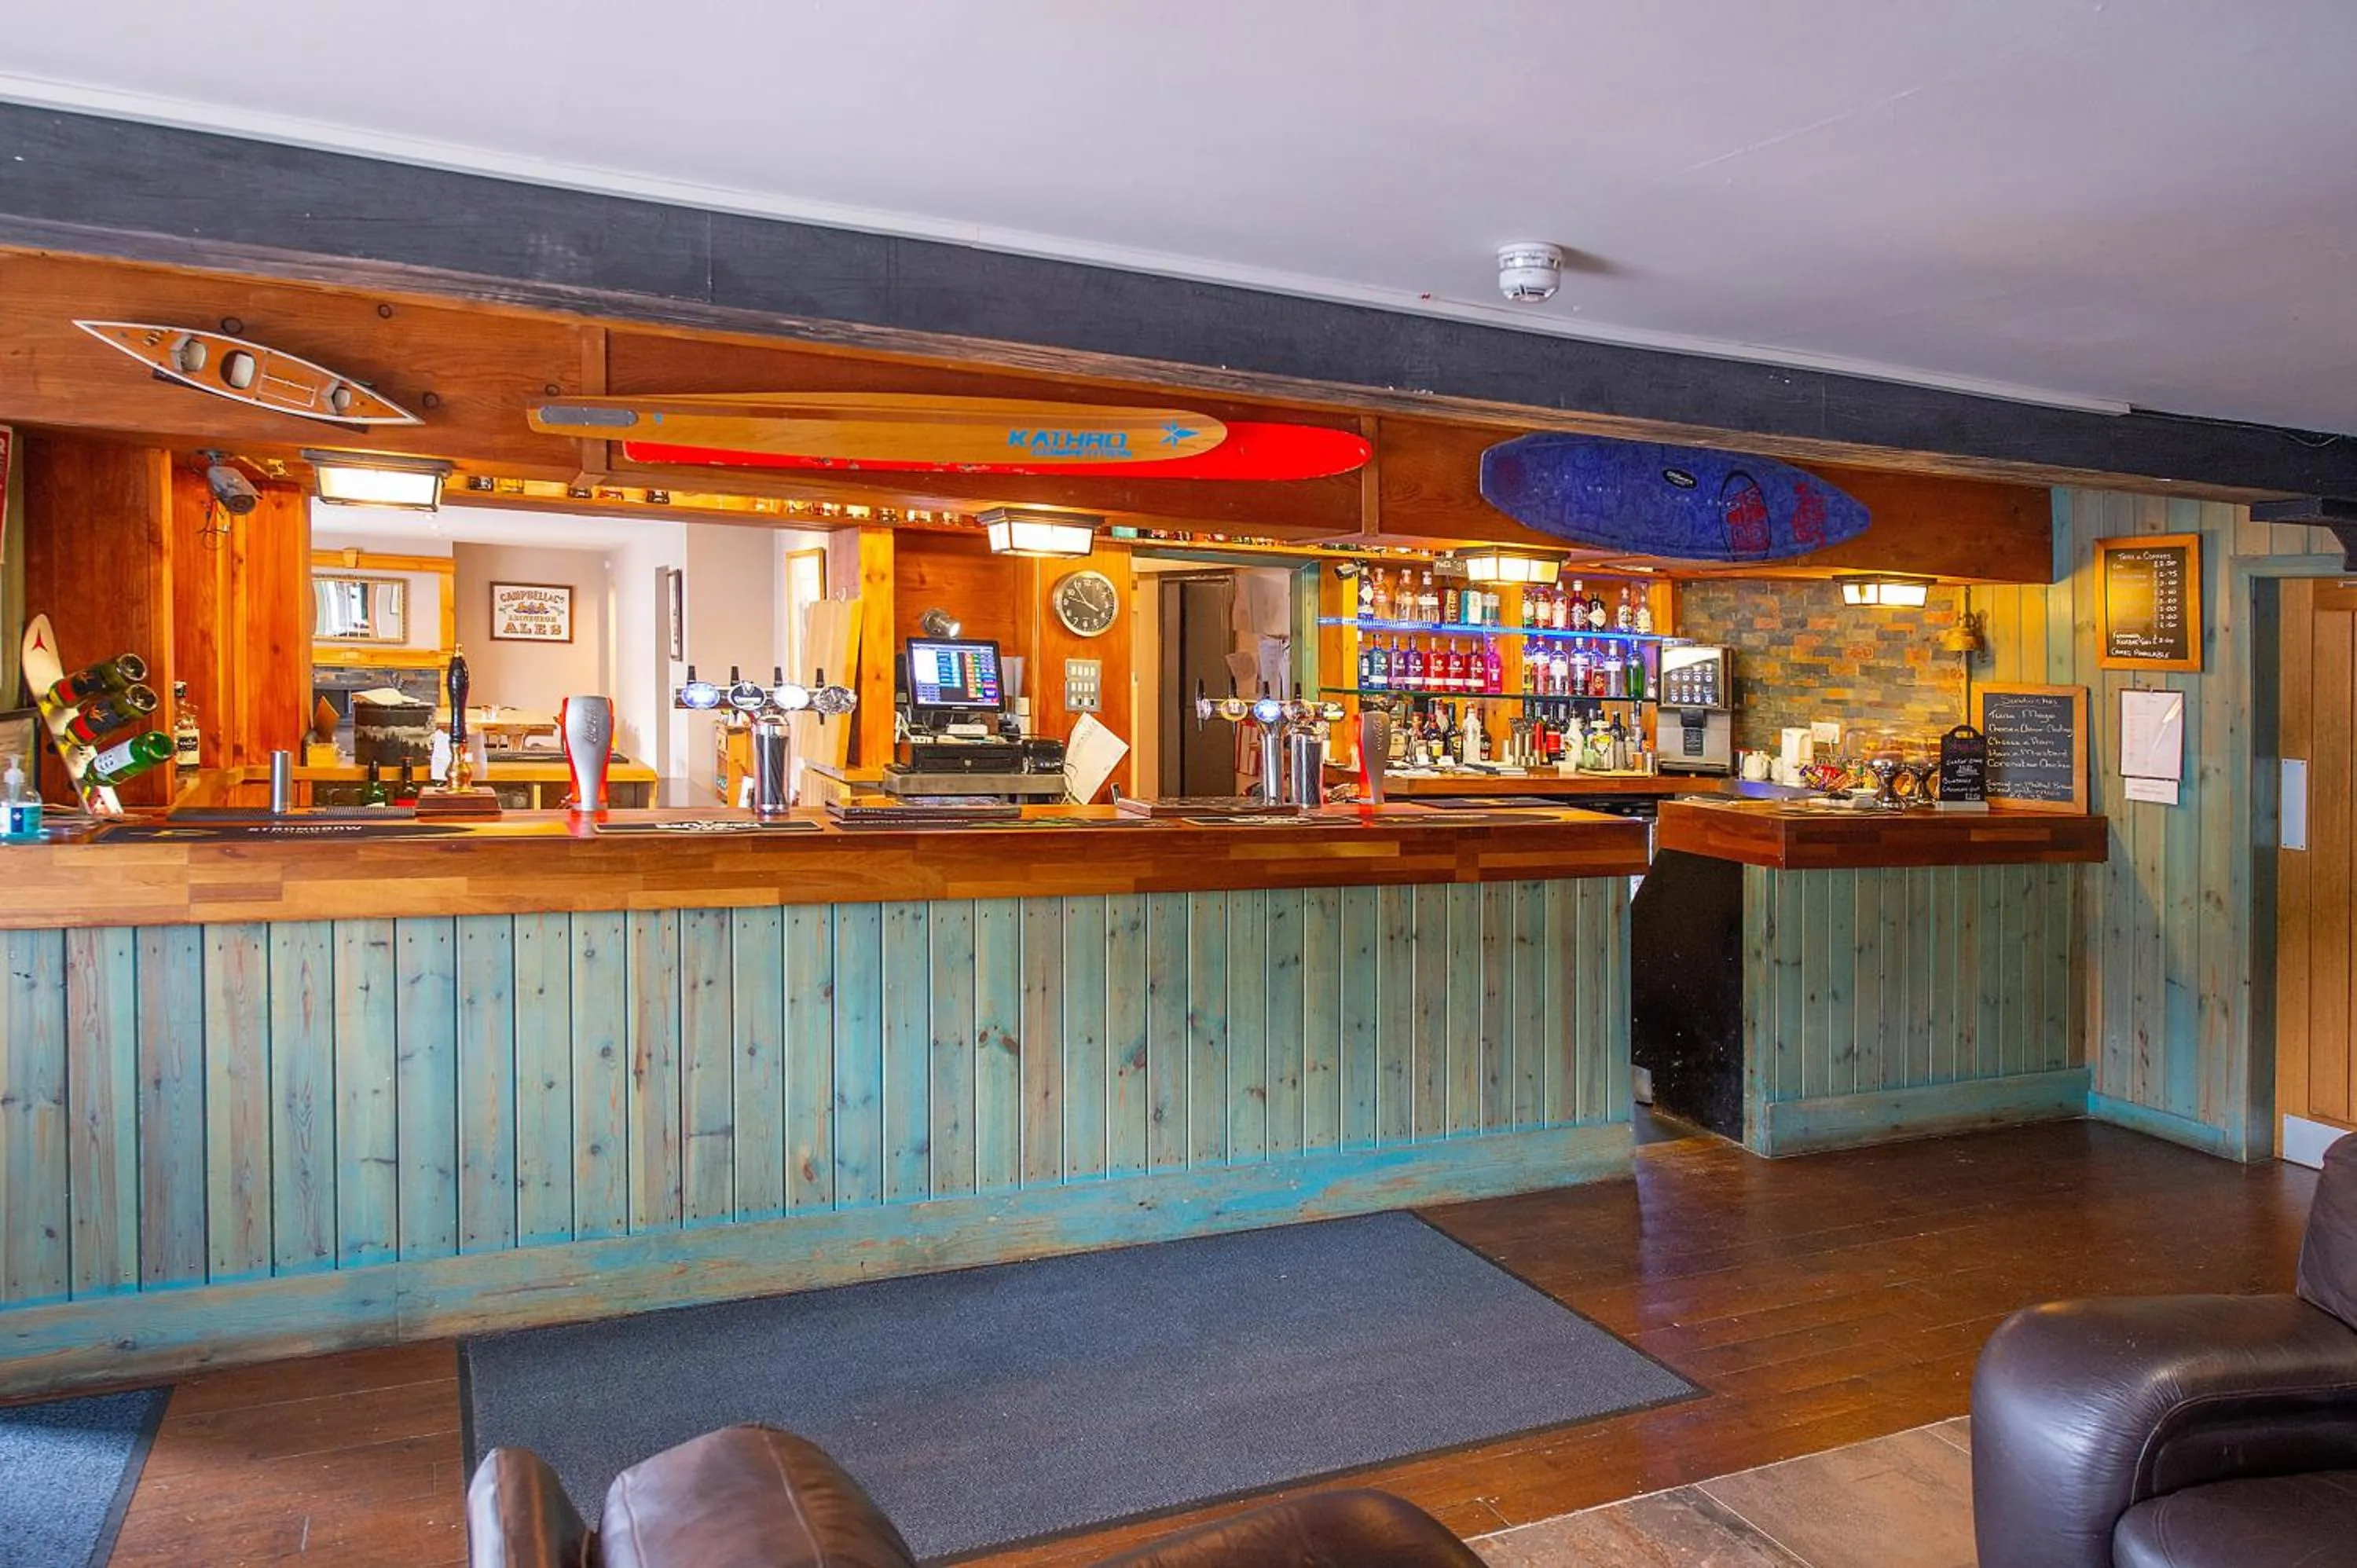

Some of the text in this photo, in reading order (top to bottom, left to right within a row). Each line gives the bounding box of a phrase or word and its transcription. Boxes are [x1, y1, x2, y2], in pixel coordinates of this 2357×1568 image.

[1007, 430, 1128, 447] KATHRO
[503, 621, 562, 635] ALES
[1988, 709, 2056, 724] Tuna Mayo
[1987, 737, 2021, 746] Cheese
[1987, 759, 2037, 768] Coronation
